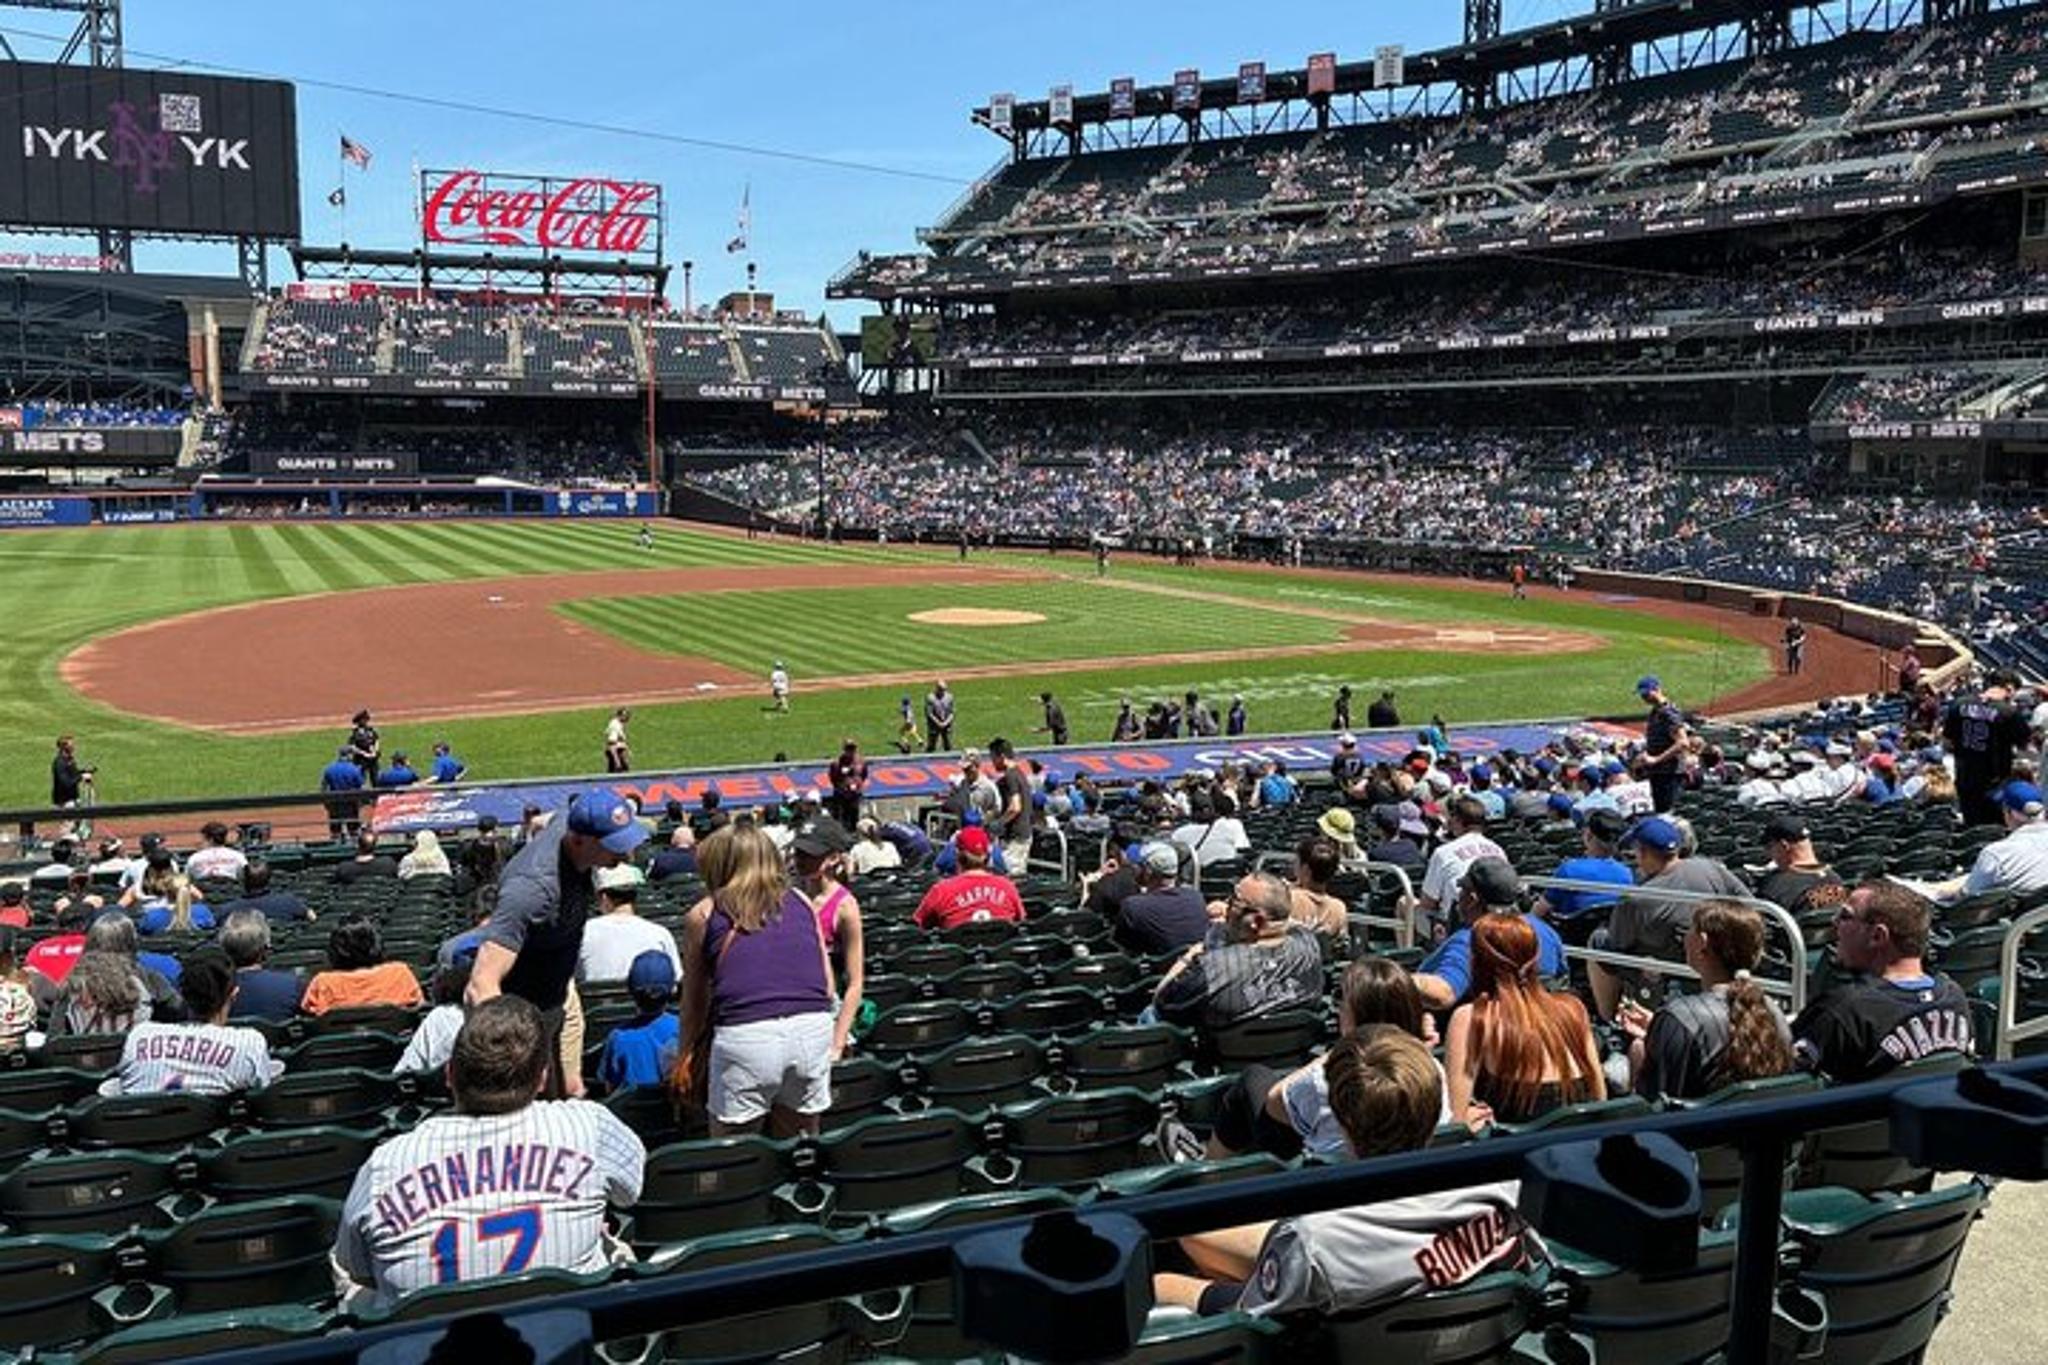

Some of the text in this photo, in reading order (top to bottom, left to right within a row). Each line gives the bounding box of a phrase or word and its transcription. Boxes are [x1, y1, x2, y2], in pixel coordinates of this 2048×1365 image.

[23, 126, 108, 160] IYK
[180, 136, 251, 169] YK
[1942, 298, 2048, 319] GIANTS ME
[1754, 315, 1819, 331] GIANTS
[1849, 423, 1981, 437] GIANTS METS
[13, 431, 105, 452] METS
[277, 458, 337, 470] GIANTS
[1060, 752, 1173, 774] TO
[136, 1034, 236, 1070] ROSARIO
[374, 1143, 594, 1238] HERNANDEZ
[429, 1203, 544, 1284] 17
